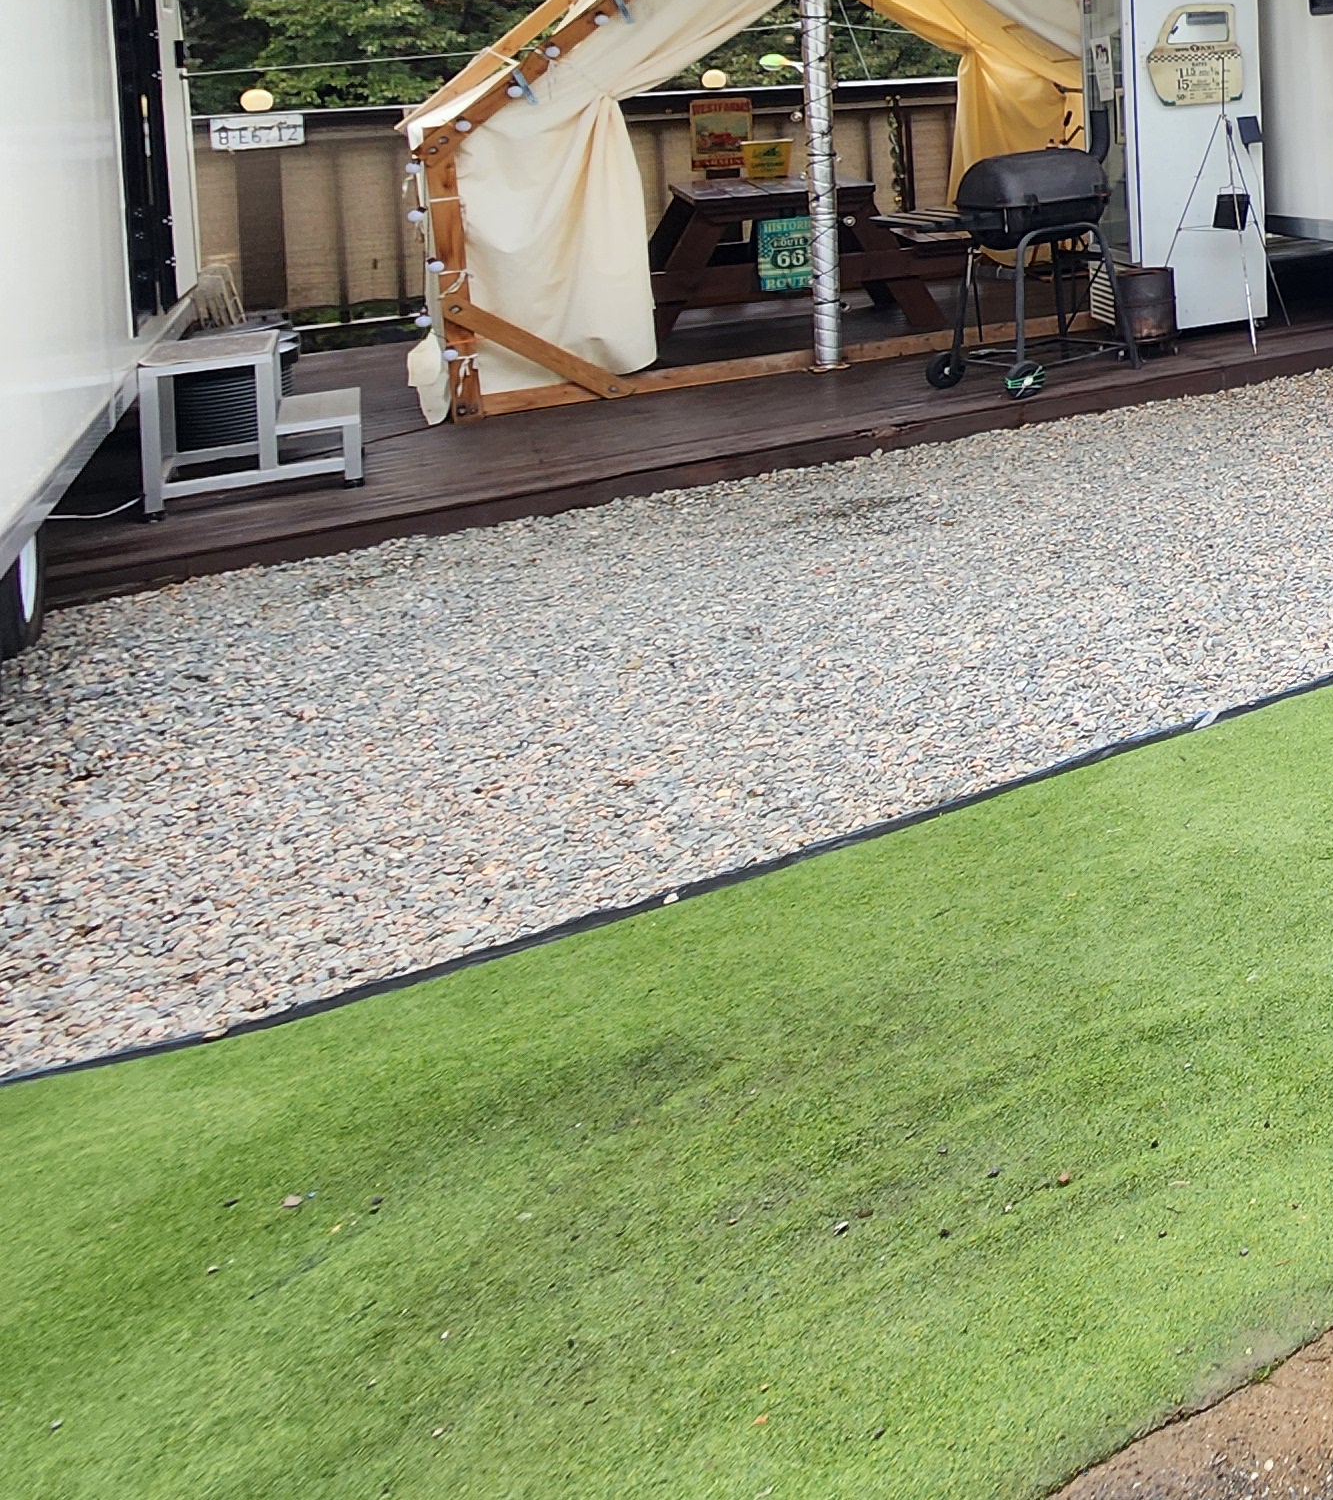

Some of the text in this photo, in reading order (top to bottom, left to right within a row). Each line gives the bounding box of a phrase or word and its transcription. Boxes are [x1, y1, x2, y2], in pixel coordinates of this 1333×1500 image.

[763, 220, 812, 233] HISTORI
[773, 238, 805, 248] ROUTE
[777, 249, 805, 268] 66
